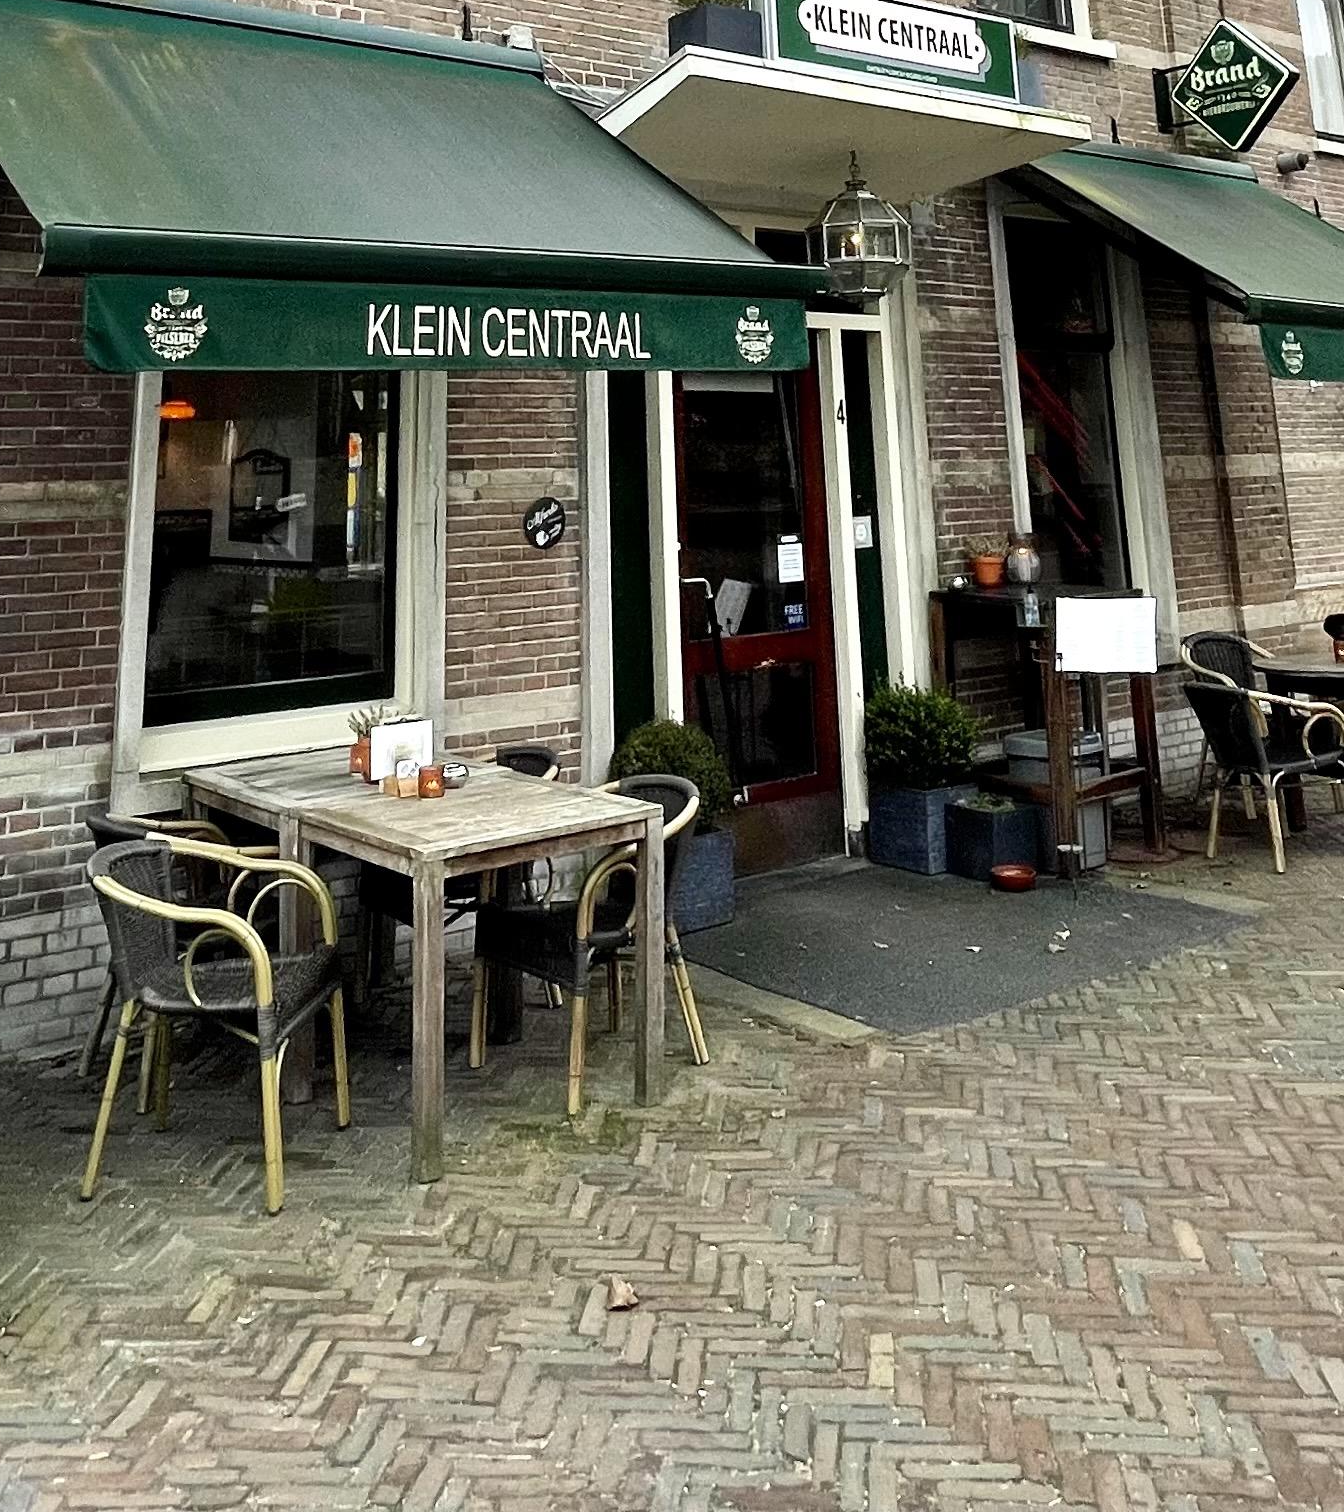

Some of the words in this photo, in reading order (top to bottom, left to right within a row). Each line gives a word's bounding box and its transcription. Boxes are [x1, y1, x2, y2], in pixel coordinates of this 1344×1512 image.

[814, 3, 872, 40] KLEIN
[877, 17, 974, 60] CENTRAAL
[1190, 55, 1262, 92] Brand
[367, 303, 471, 356] KLEIN
[481, 306, 652, 359] CENTRAAL
[836, 399, 846, 425] 4
[784, 603, 804, 615] FREE
